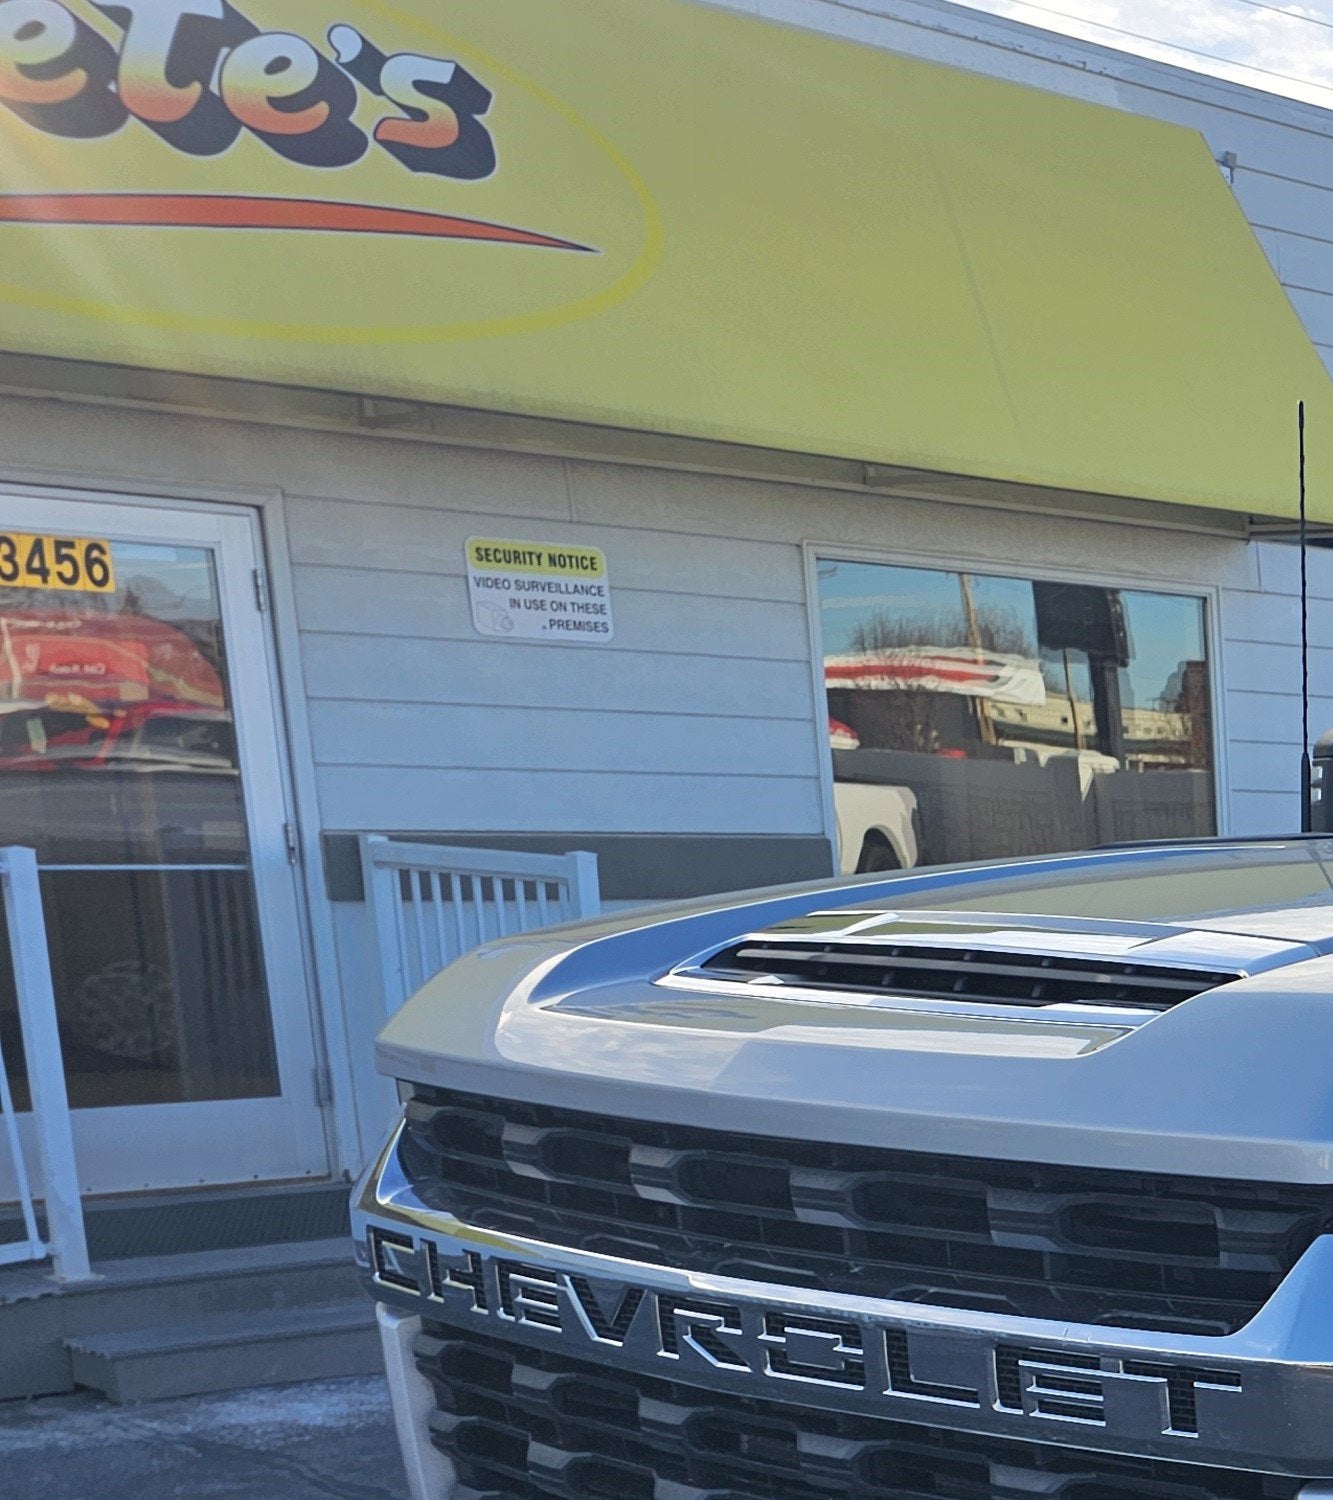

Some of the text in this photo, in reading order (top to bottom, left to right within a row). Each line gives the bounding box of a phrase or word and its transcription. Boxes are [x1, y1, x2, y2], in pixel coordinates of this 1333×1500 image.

[475, 547, 598, 571] SECURITY NOTICE
[473, 576, 605, 597] VIDEO SURVEILLANCE
[509, 598, 607, 615] IN USE ON THESE
[549, 618, 609, 633] PREMISES
[366, 1225, 1242, 1438] CHEVROLET
